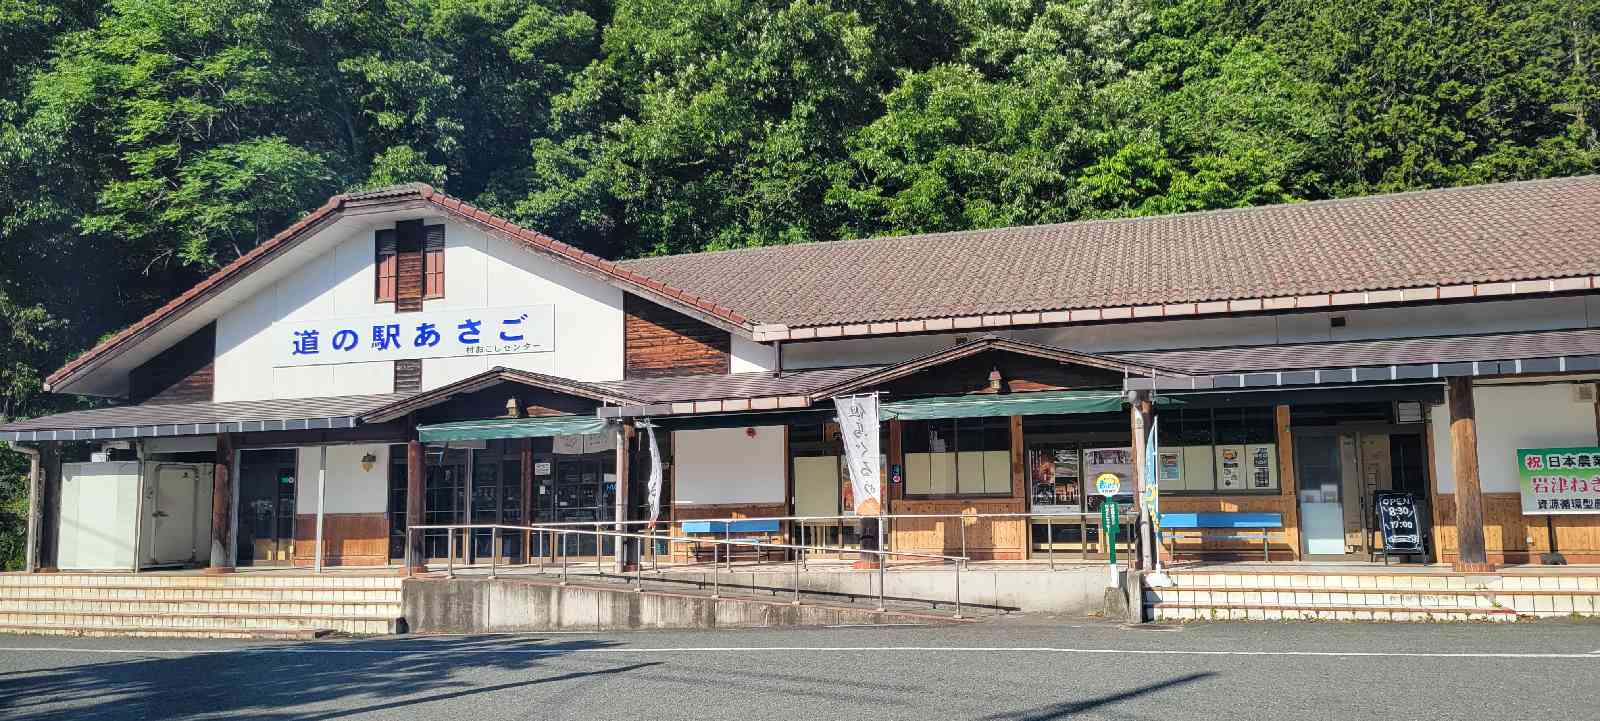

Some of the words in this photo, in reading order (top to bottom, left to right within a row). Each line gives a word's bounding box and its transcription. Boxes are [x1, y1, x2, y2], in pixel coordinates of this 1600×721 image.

[292, 314, 528, 356] 道の駅あさご
[465, 343, 542, 354] 村おこしセンター
[1526, 456, 1543, 468] 祝
[1382, 498, 1411, 506] OPEN
[1389, 506, 1409, 516] 8:30
[1390, 520, 1413, 529] 17:00
